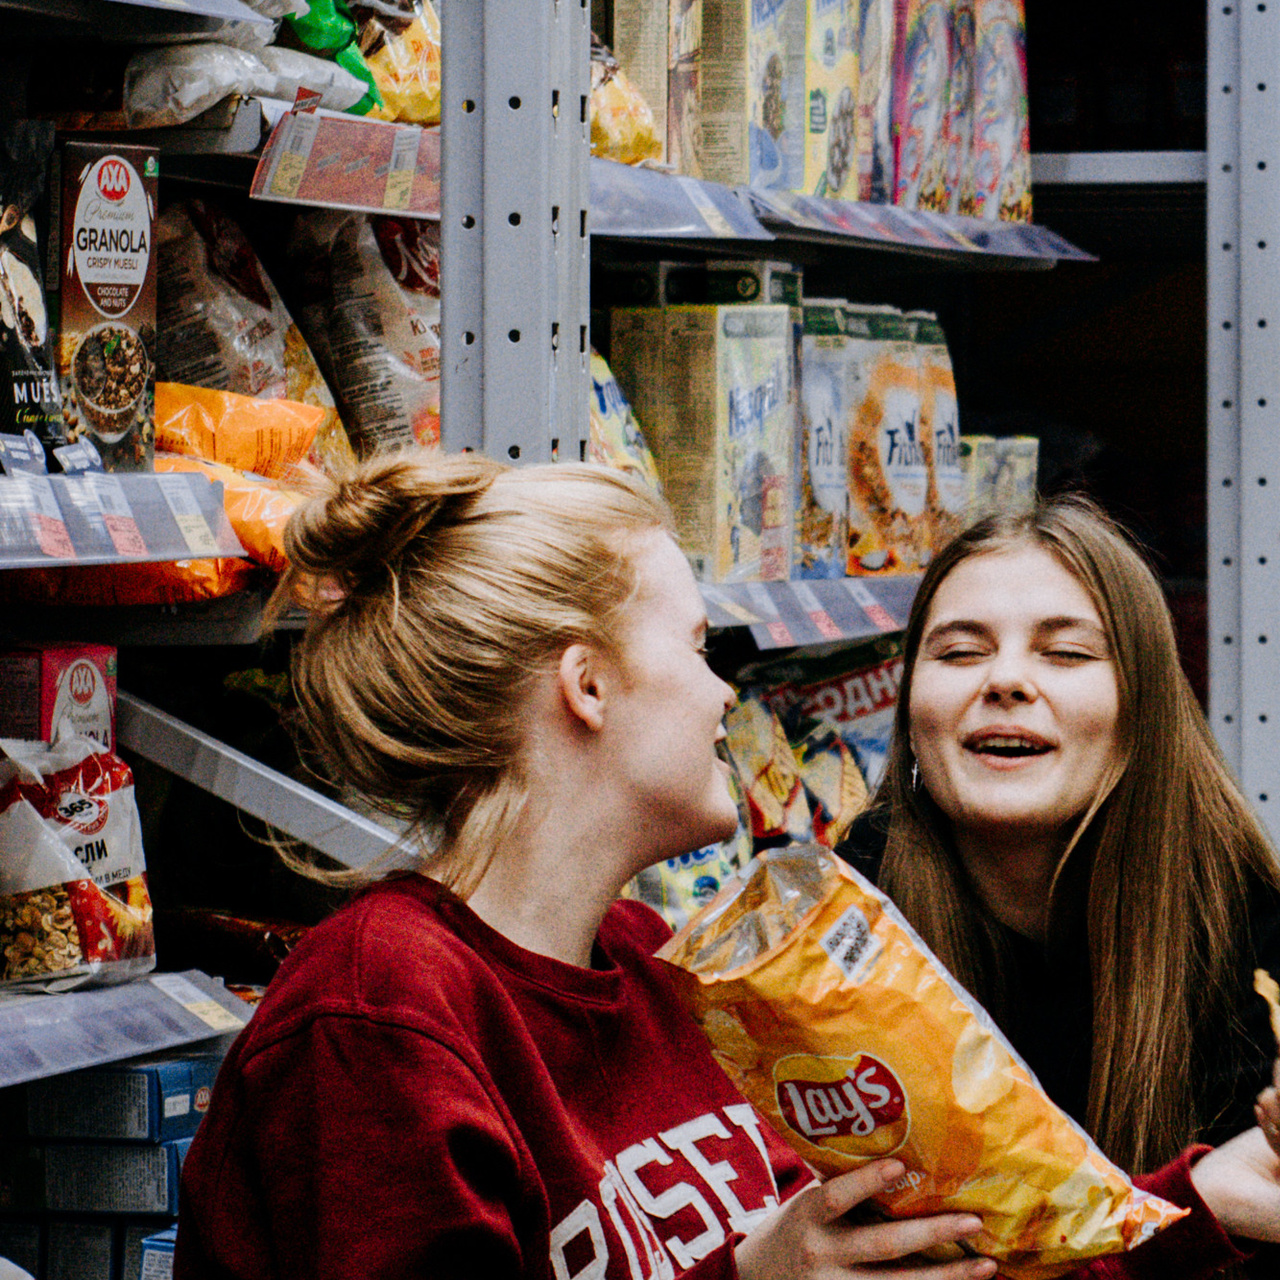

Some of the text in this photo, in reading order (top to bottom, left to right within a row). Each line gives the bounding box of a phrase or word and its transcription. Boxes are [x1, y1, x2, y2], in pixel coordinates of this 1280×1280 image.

[100, 163, 127, 192] AXA
[76, 227, 148, 253] GRANOLA
[87, 256, 139, 270] CRISPY MUESLI
[97, 286, 129, 297] CHOCOLATE
[58, 799, 94, 819] 365
[73, 837, 109, 864] СЛИ
[784, 1066, 891, 1137] Lay's
